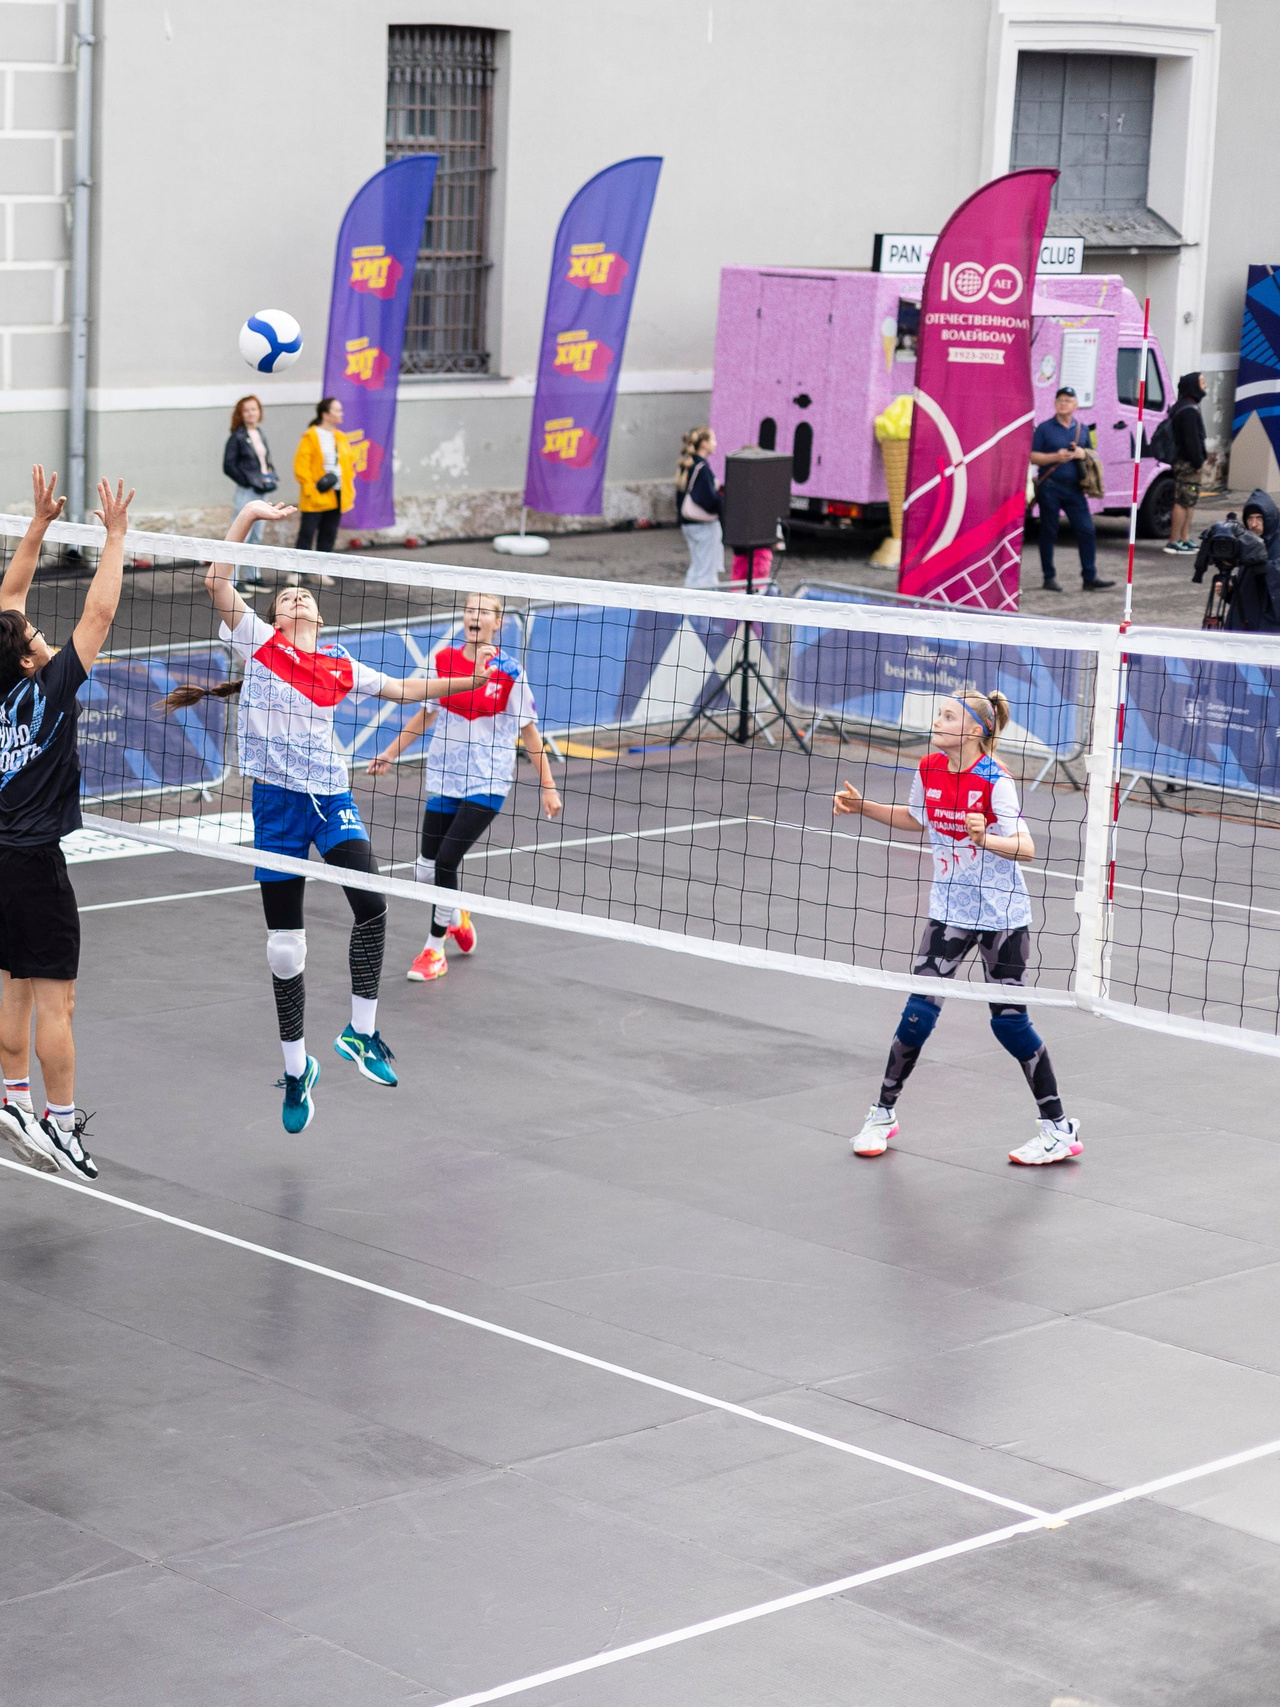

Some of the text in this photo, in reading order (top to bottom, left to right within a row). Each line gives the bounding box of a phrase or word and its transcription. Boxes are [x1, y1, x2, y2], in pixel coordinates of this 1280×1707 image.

[890, 245, 1076, 265] PAN CLUB
[994, 279, 1013, 290] ЛЕТ
[941, 329, 1016, 344] ВОЛЕЙБОЛУ
[954, 352, 1000, 362] 1923-2023
